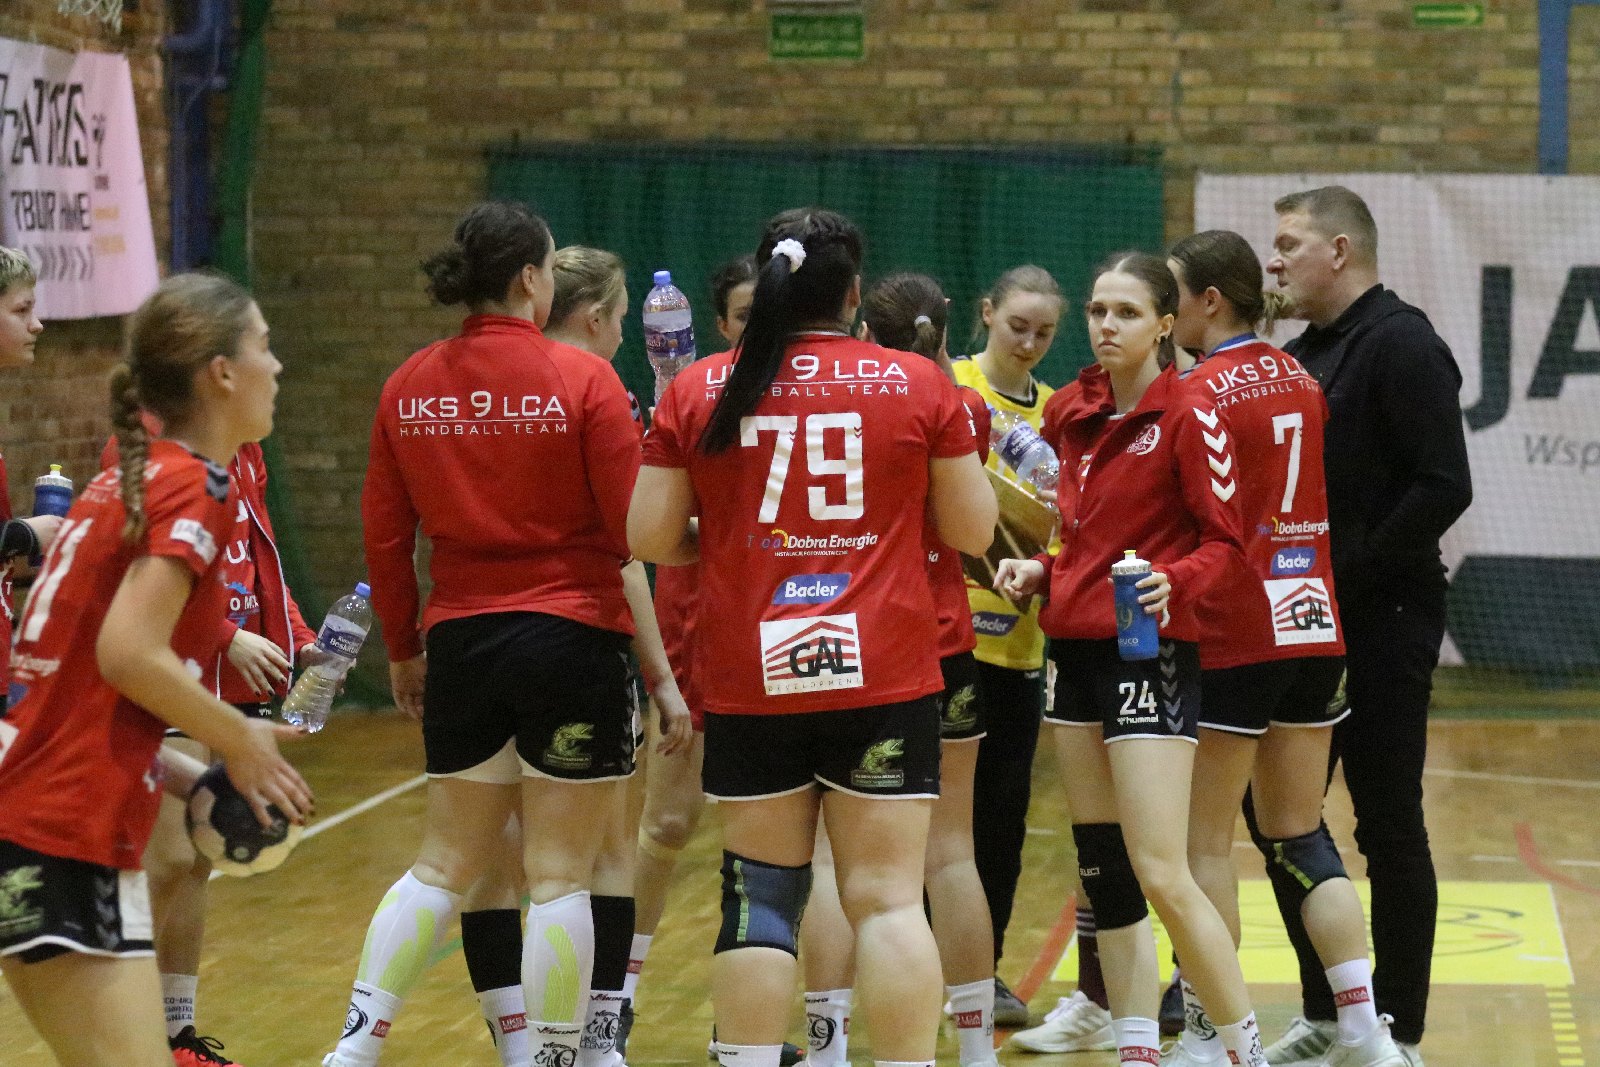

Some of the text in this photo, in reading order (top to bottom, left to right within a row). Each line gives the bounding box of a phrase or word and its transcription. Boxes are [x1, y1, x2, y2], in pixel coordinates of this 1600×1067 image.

[791, 355, 908, 380] 9 LCA
[1206, 364, 1260, 394] UKS
[1259, 355, 1279, 378] 9
[398, 390, 566, 419] UKS 9 LCA
[706, 384, 908, 402] HBALL TEAM
[1216, 384, 1293, 410] HANDBALL
[400, 423, 567, 437] HANDBALL TEAM
[740, 412, 864, 523] 79
[1272, 412, 1303, 512] 7
[787, 535, 828, 549] Dobra
[828, 532, 879, 550] Energia
[1280, 522, 1302, 535] Dobra
[784, 581, 838, 598] Bacler
[1290, 596, 1334, 630] GAL
[789, 636, 859, 678] GAL
[1119, 680, 1158, 716] 24
[1126, 715, 1159, 725] hummel
